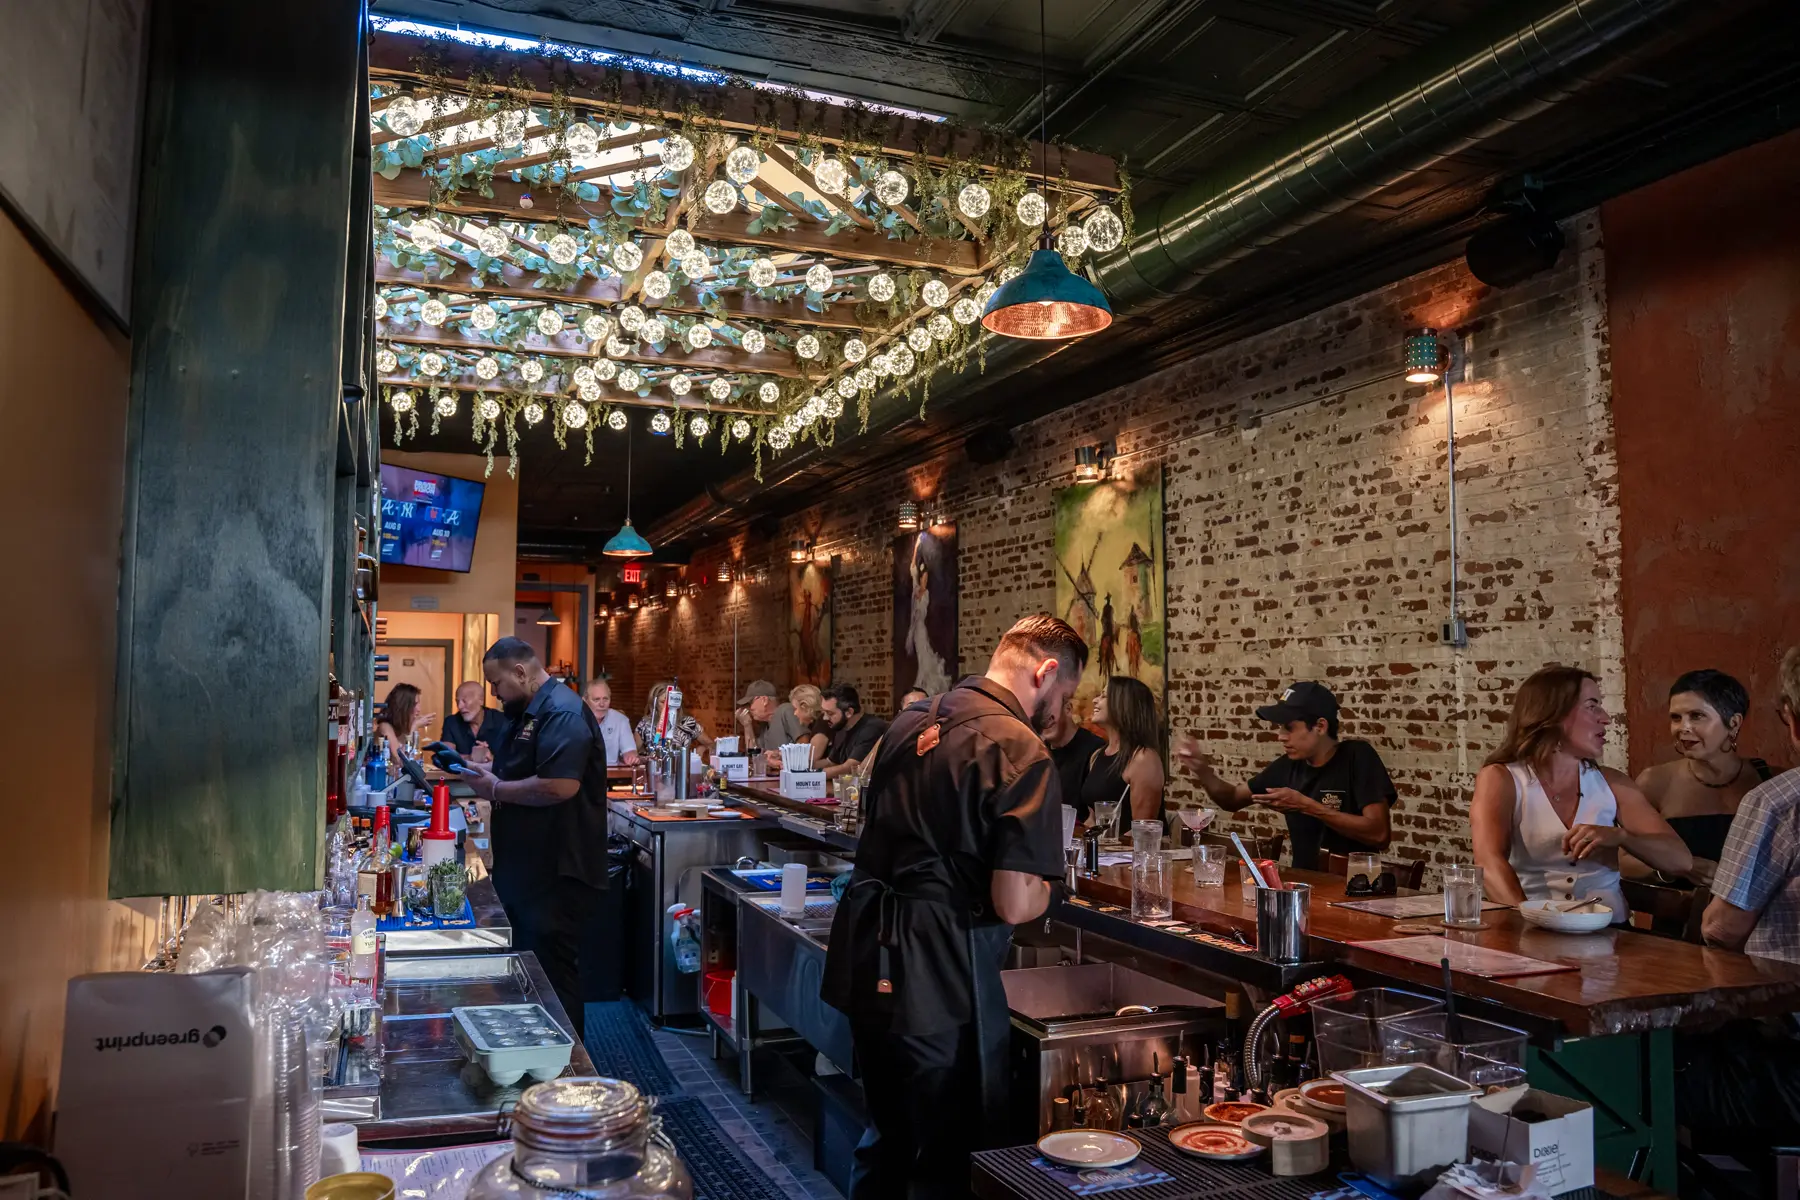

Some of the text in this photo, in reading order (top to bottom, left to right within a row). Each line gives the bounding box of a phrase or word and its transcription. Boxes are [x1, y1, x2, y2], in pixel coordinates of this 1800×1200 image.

[384, 521, 397, 530] AUG
[432, 528, 450, 538] AUG 10
[625, 570, 640, 582] EXIT
[95, 1028, 200, 1053] greenprint
[1533, 1143, 1558, 1158] Dixie
